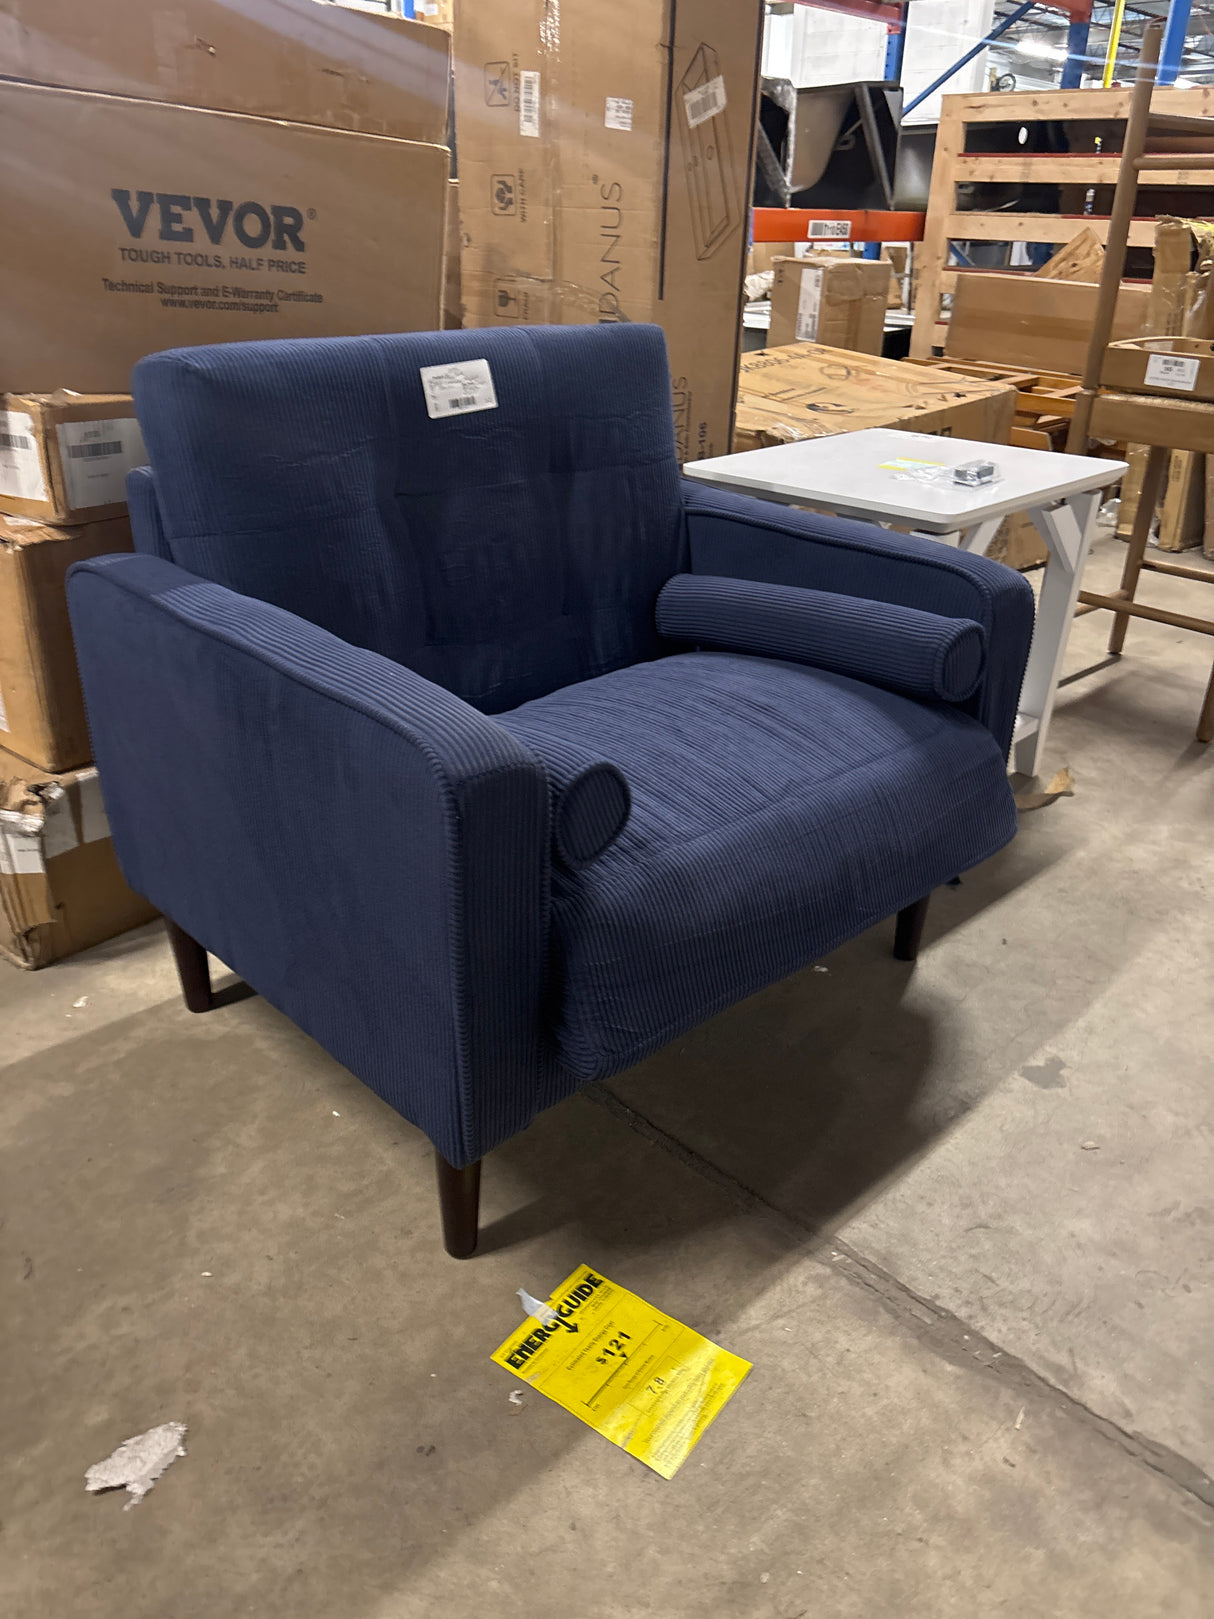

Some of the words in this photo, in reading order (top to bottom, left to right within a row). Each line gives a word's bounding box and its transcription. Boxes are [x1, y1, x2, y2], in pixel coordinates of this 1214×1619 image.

[111, 188, 305, 252] VEVOR
[119, 247, 171, 264] TOUGH
[229, 256, 264, 271] HALF
[267, 258, 306, 274] PRICE
[102, 278, 154, 295] Technical
[156, 281, 200, 298] Support
[200, 286, 220, 298] and
[221, 285, 275, 302] E-Warranty
[276, 289, 324, 305] Certificate
